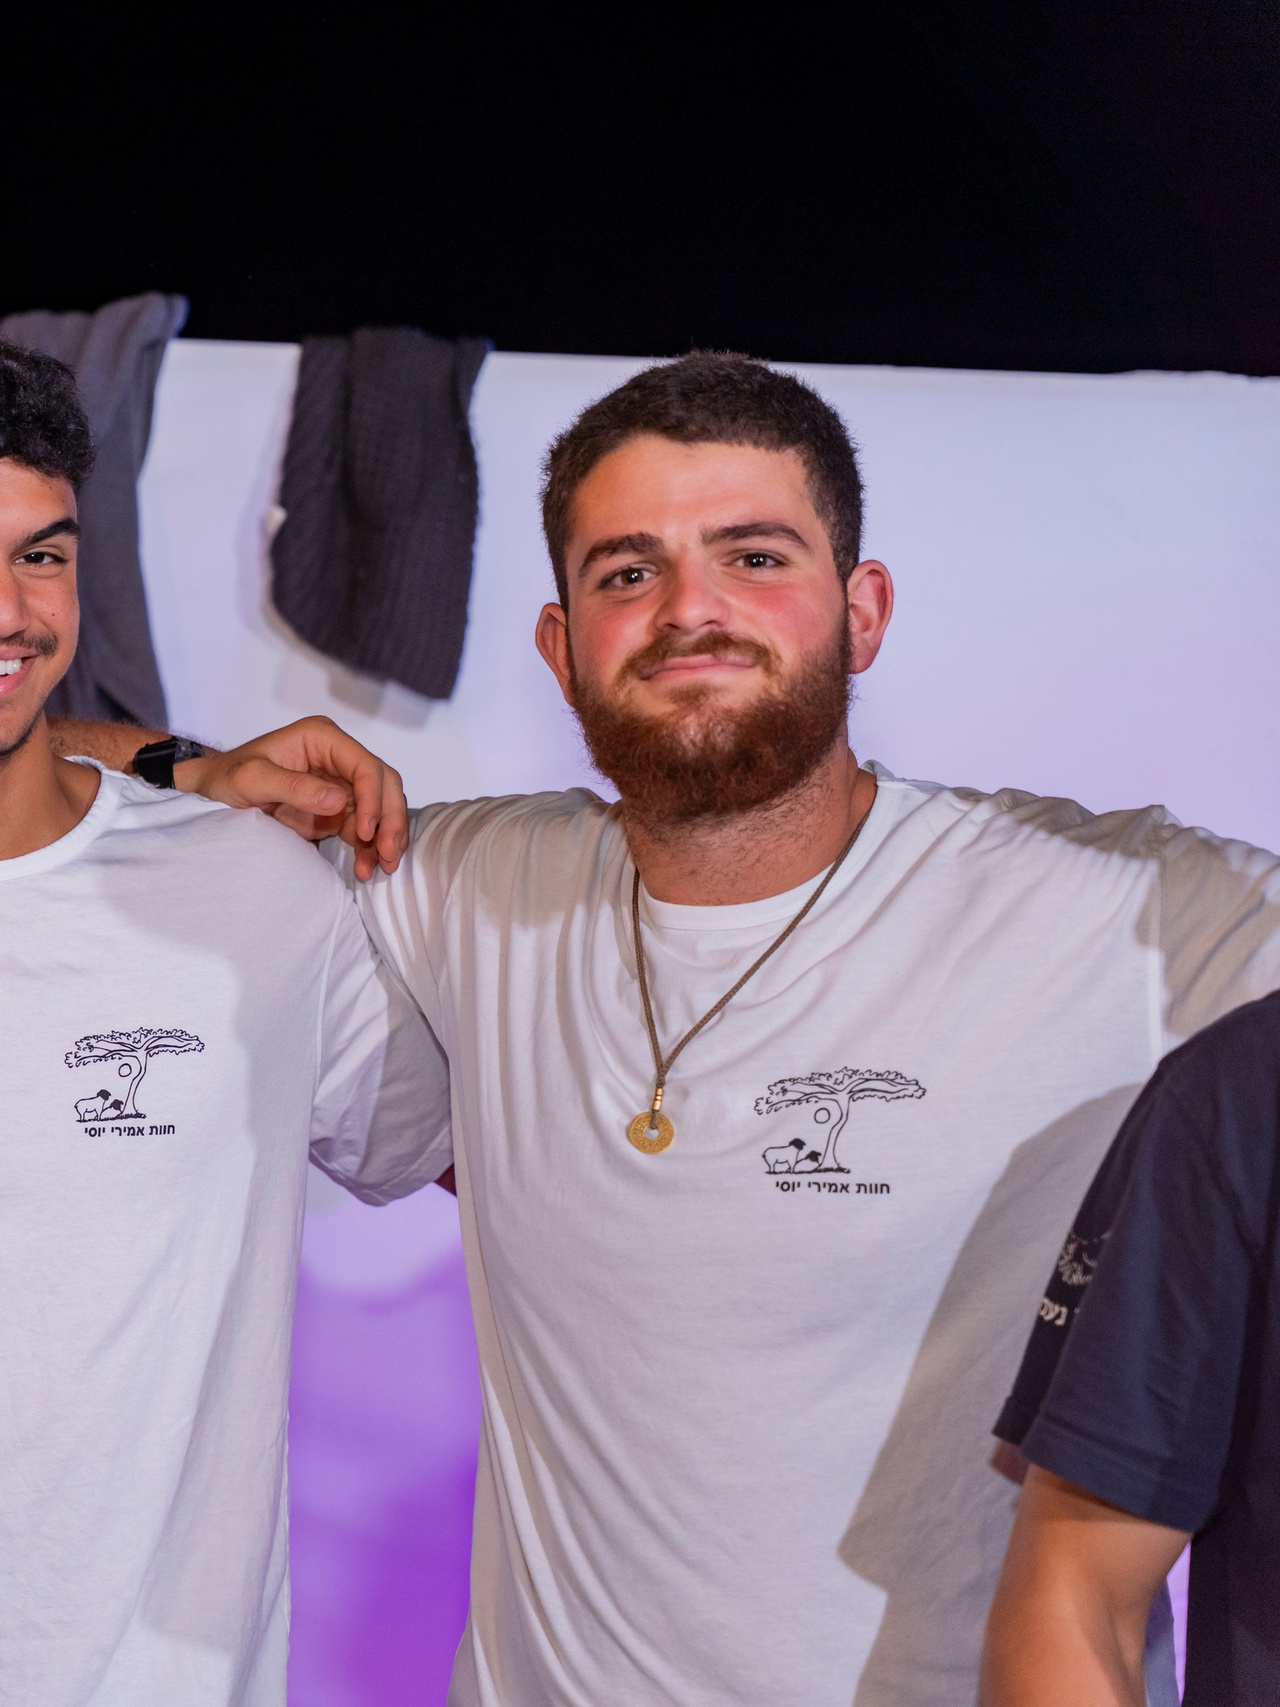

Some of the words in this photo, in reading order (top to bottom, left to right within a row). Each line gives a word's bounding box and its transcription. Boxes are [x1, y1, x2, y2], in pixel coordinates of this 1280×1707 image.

[84, 1126, 106, 1138] יוסי
[111, 1125, 145, 1137] אמירי
[148, 1124, 176, 1136] חוות
[775, 1181, 801, 1193] יוסי
[808, 1181, 850, 1194] אמירי
[855, 1183, 891, 1194] חוות
